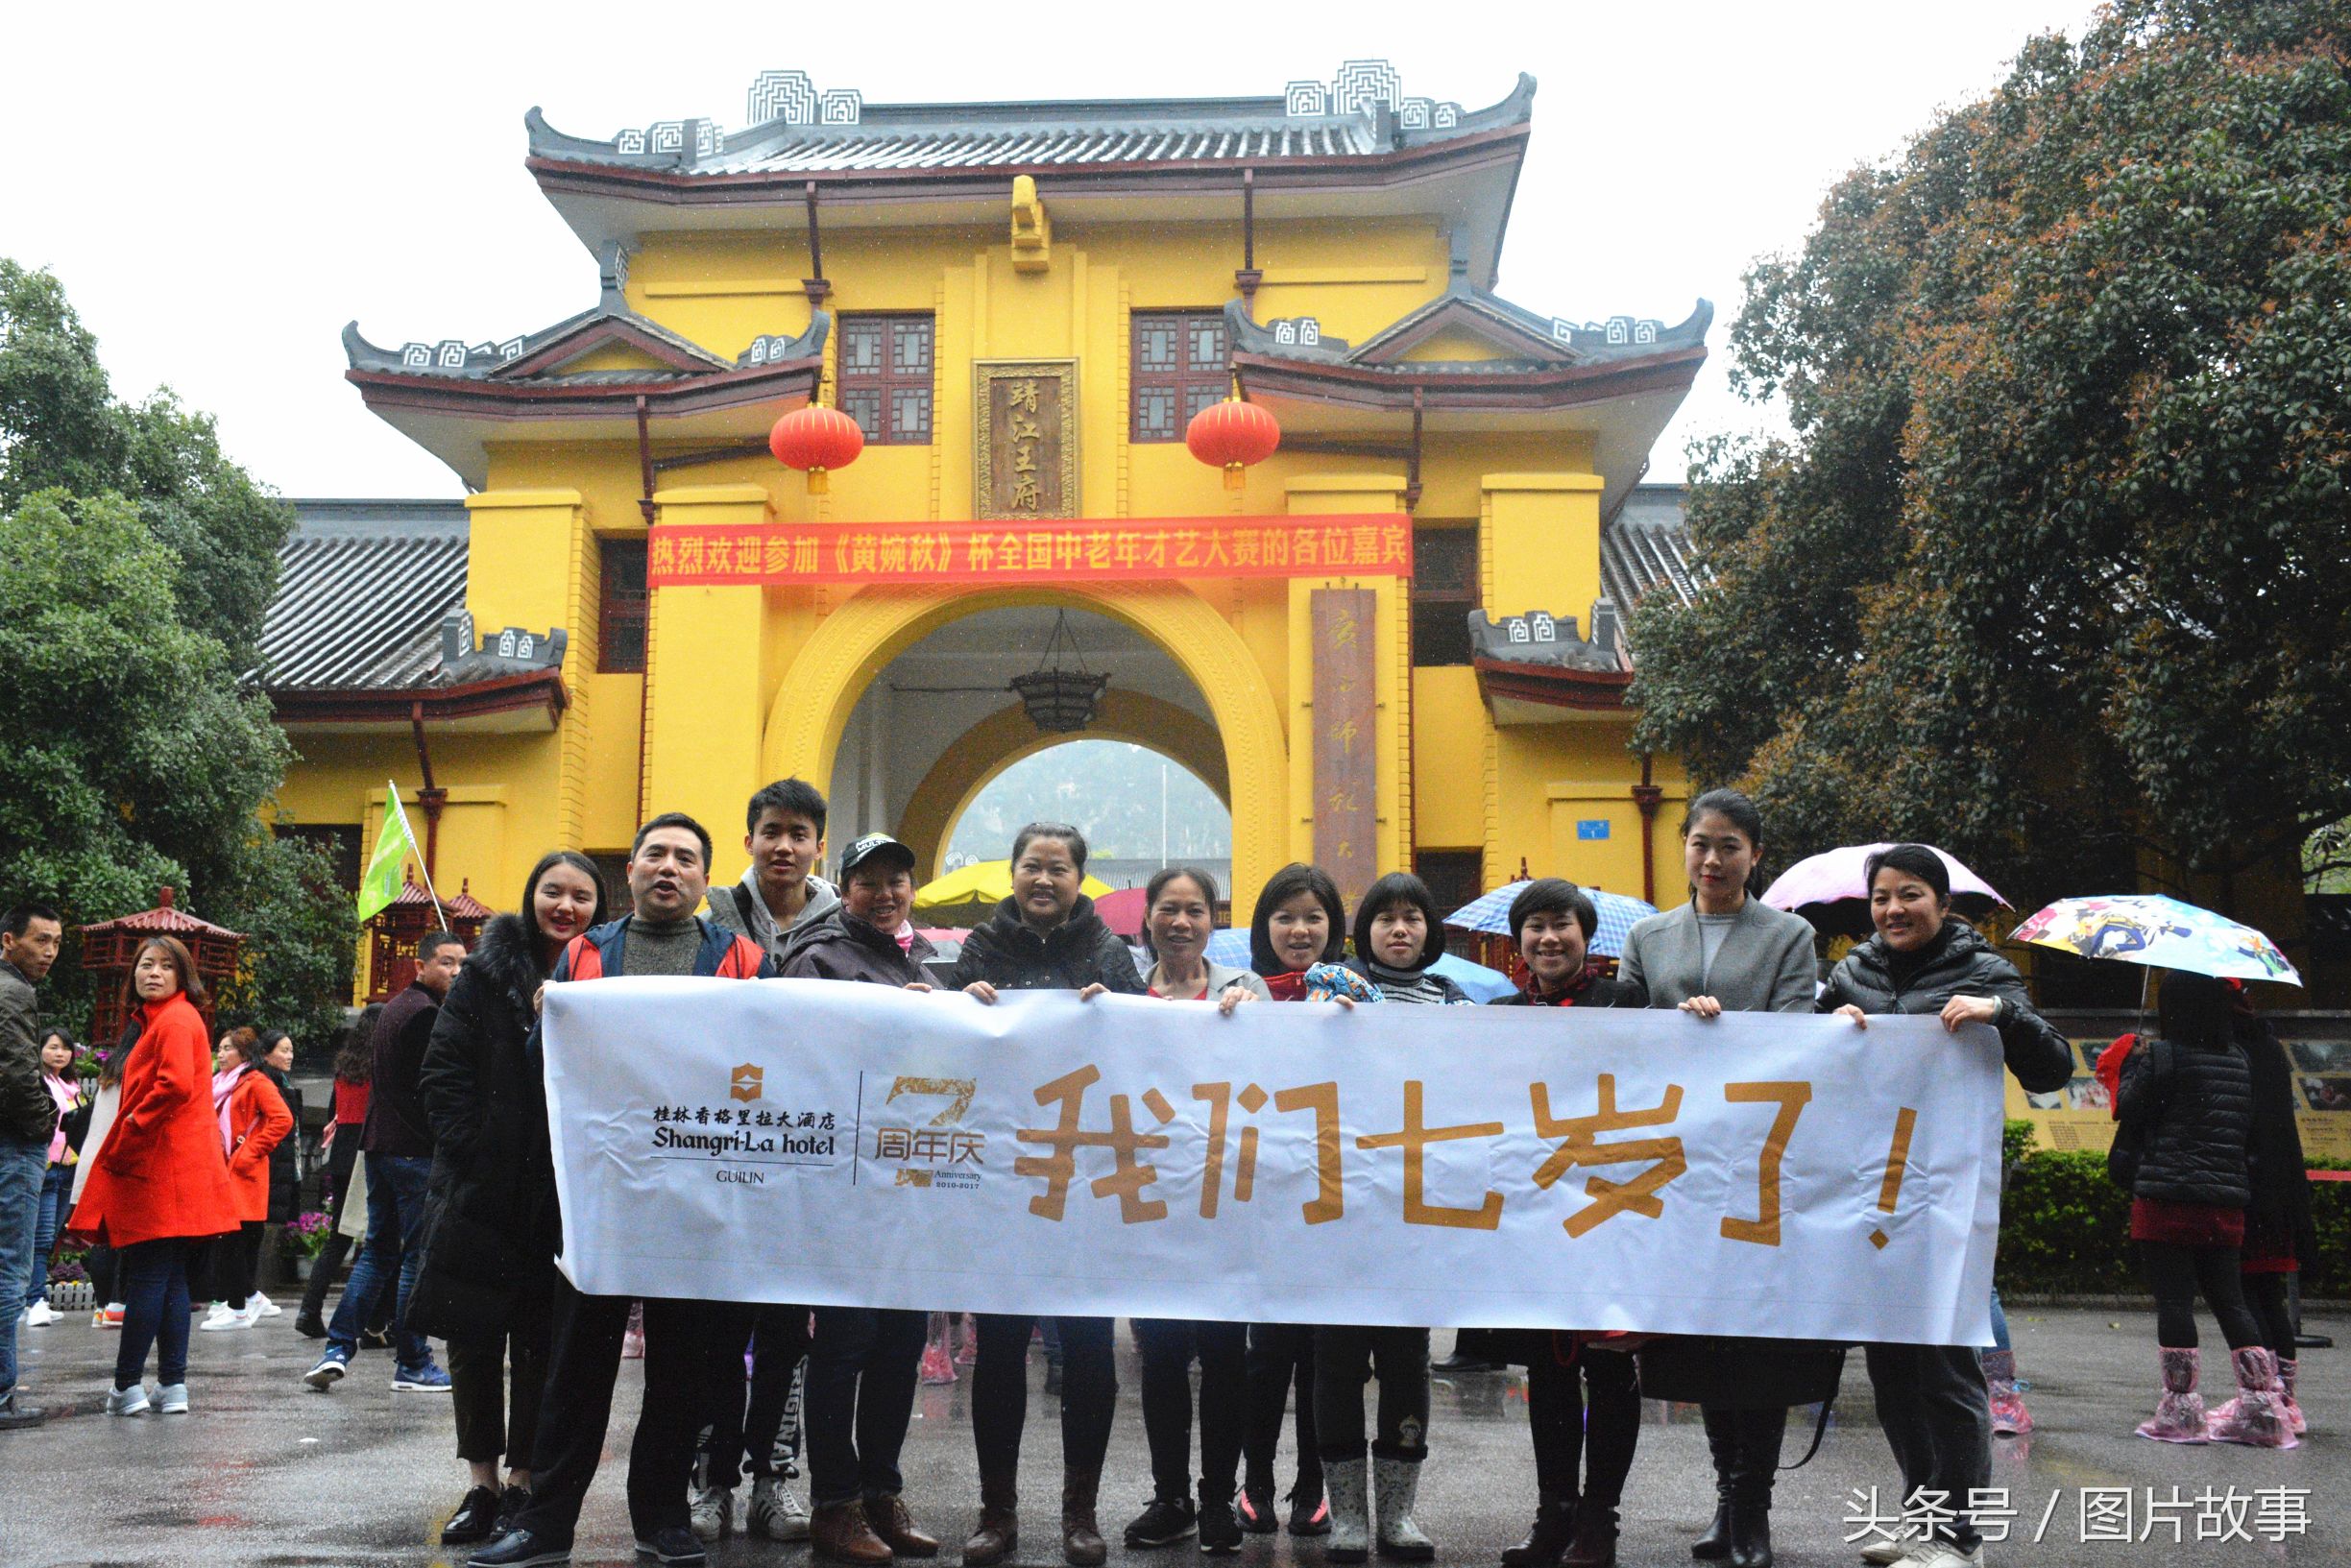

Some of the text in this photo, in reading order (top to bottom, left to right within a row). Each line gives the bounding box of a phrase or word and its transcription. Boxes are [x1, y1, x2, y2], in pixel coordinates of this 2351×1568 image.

[1010, 379, 1041, 511] 靖江王府
[653, 1105, 836, 1131] 桂林香格里拉大酒店
[652, 1125, 835, 1157] Shangri-La hotel
[875, 1127, 984, 1166] 周年庆
[1013, 1064, 1917, 1250] 我们七岁了！
[715, 1170, 764, 1185] GUILIN
[934, 1170, 982, 1182] Anniversary
[935, 1181, 980, 1190] 2010-2017
